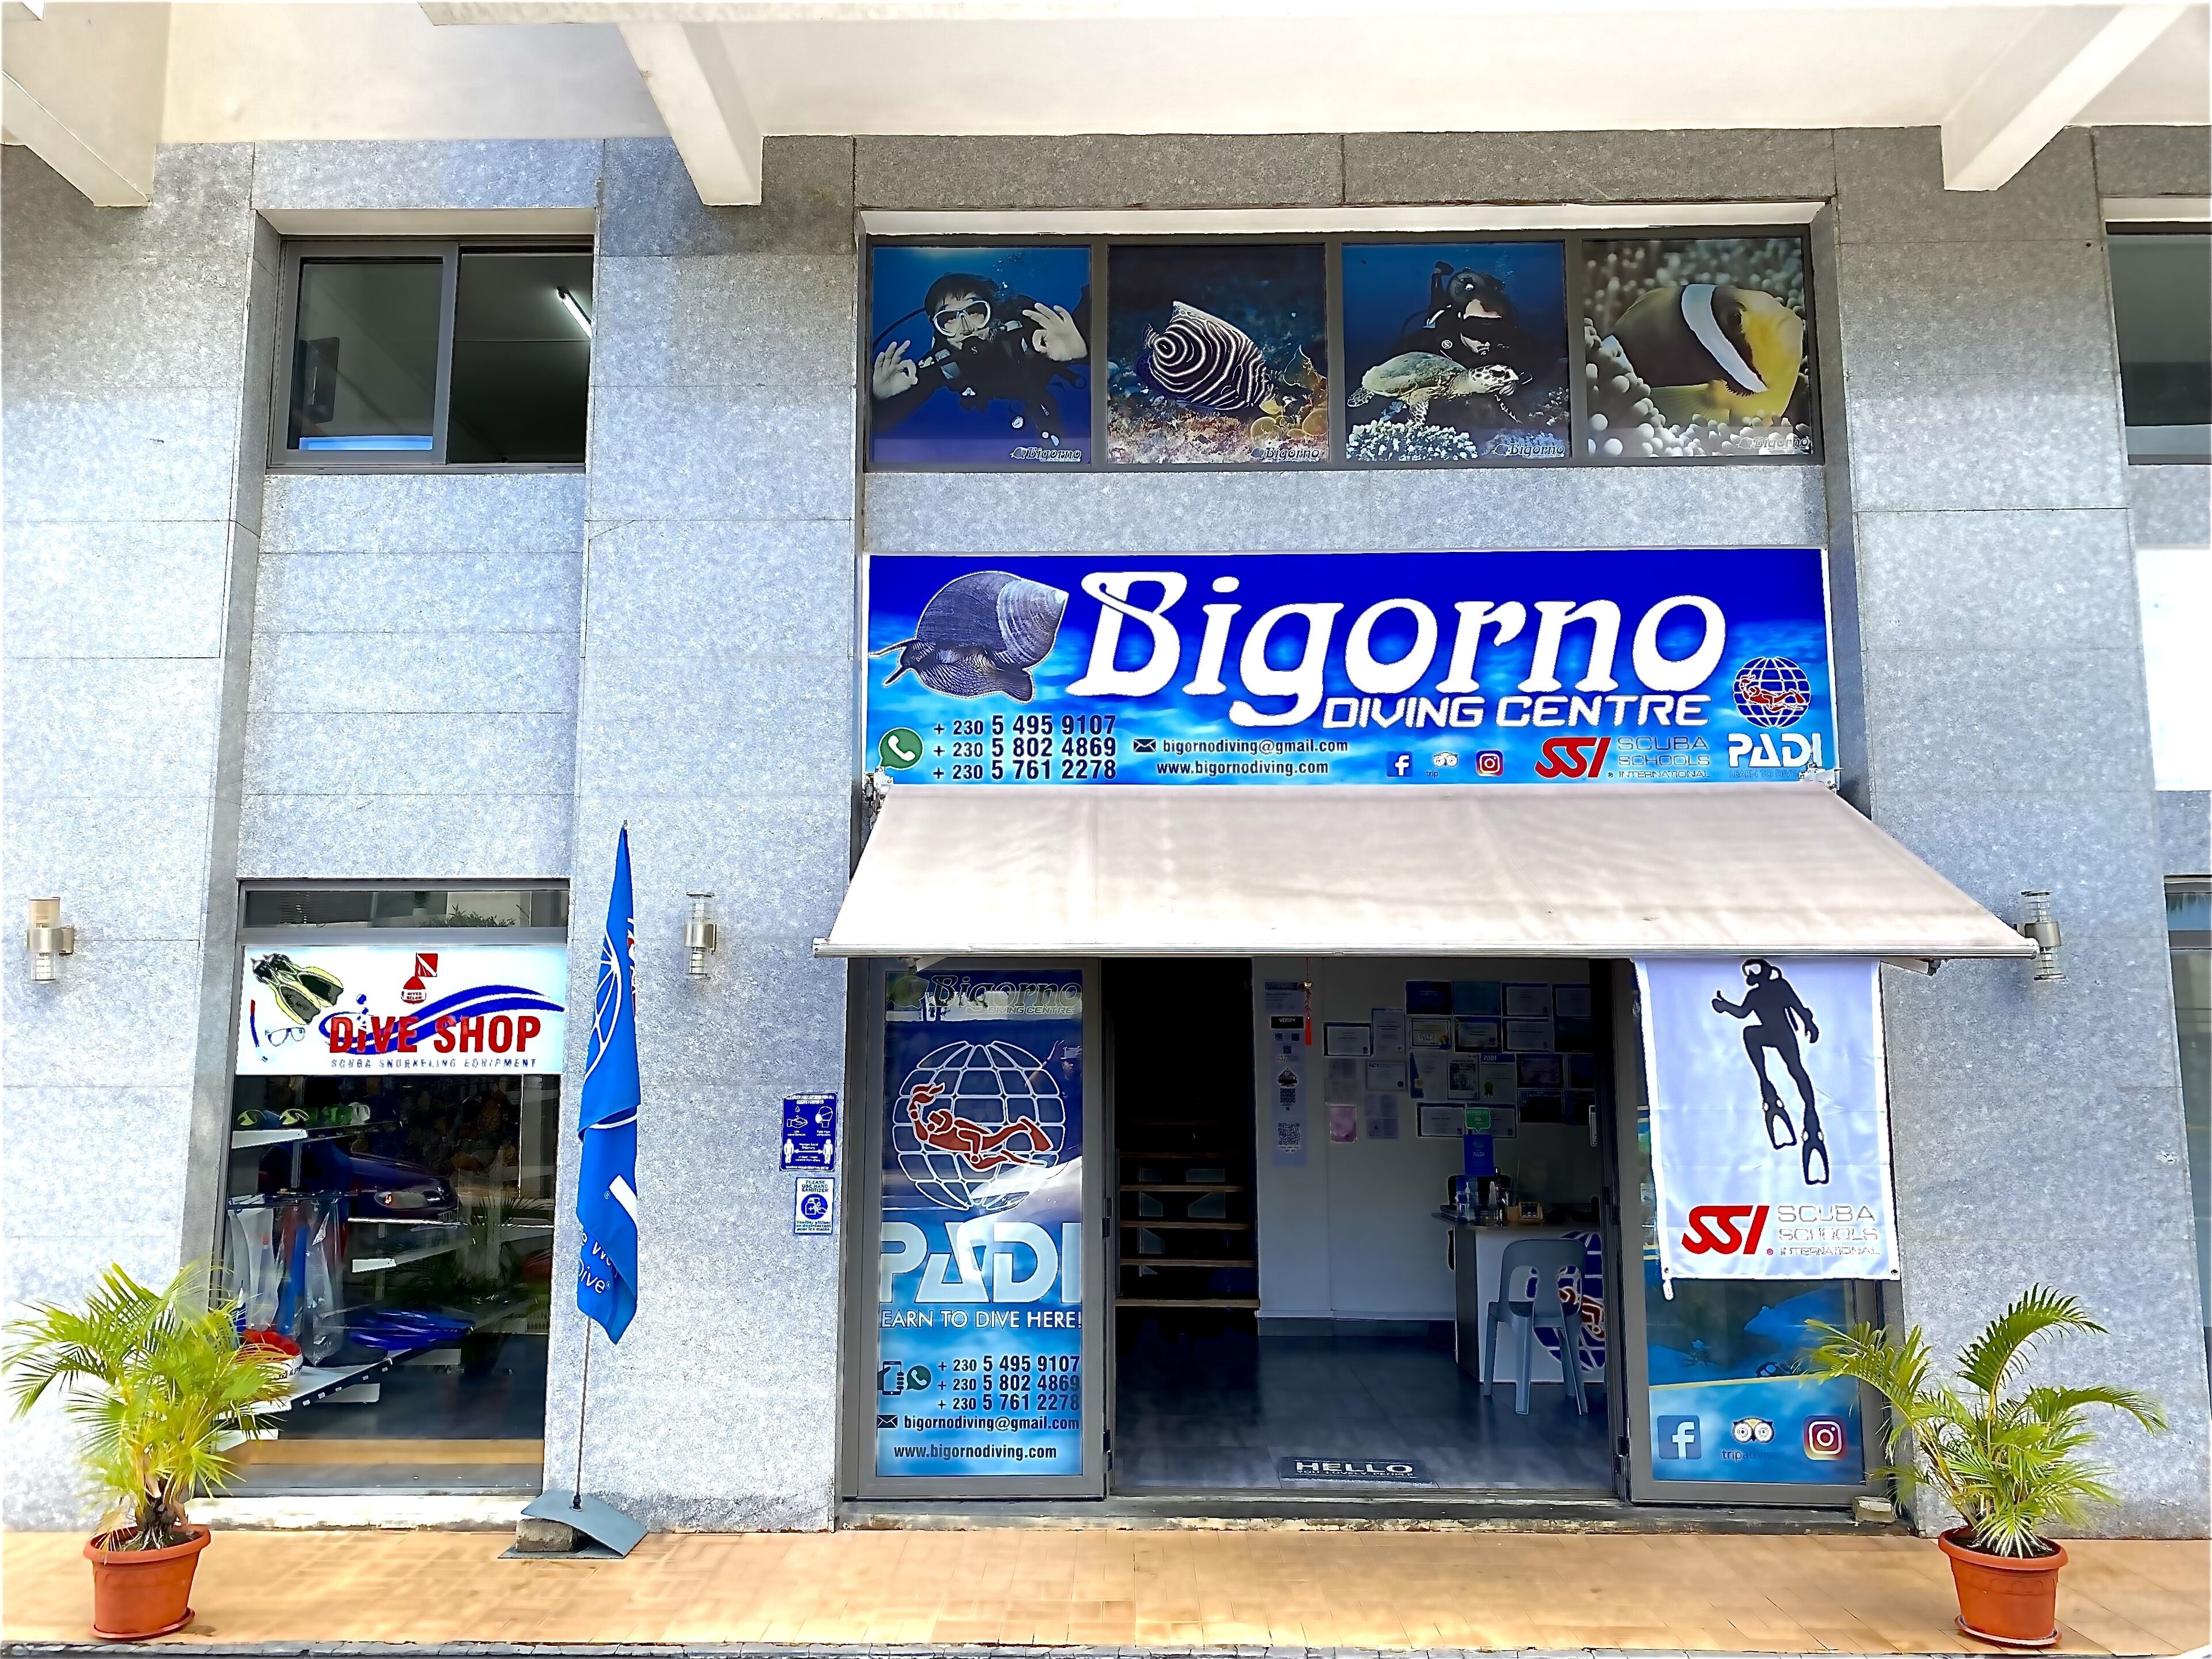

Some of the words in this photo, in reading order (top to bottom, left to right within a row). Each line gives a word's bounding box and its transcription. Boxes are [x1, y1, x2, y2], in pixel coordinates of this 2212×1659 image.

[1026, 447, 1081, 461] Bigorno
[1265, 447, 1320, 461] Bigorno
[1509, 443, 1565, 457] Bigorno
[1065, 571, 1726, 728] Bigorno
[1323, 695, 1485, 729] DIVING
[1495, 694, 1710, 728] CENTRE
[953, 720, 984, 735] 230
[992, 715, 1004, 735] 5
[1013, 715, 1053, 735] 495
[1062, 714, 1116, 735] 9107
[953, 742, 983, 757] 230
[992, 737, 1004, 757] 5
[1013, 737, 1053, 757] 802
[1062, 737, 1116, 757] 4869
[1163, 738, 1349, 755] bigornodiving@gmail.com
[1618, 736, 1709, 751] SCUBA
[1728, 733, 1823, 767] PADI
[1535, 737, 1612, 778] SSI
[1618, 755, 1710, 767] SCHOOLS
[952, 764, 983, 779] 230
[991, 759, 1003, 779] 5
[1013, 759, 1051, 779] 761
[1062, 759, 1116, 779] 2278
[1157, 760, 1329, 777] www.bigornodiving.com
[1618, 770, 1711, 778] INTERNATIONAL
[1730, 770, 1757, 778] LEARN
[1760, 770, 1773, 778] TO
[1776, 770, 1797, 778] DIVE
[931, 975, 1082, 1015] Bigorno
[986, 1007, 1025, 1015] DIVING
[1025, 1007, 1075, 1015] CENTRE
[434, 1016, 541, 1053] SHOP
[331, 1059, 372, 1068] SCUBA
[379, 1058, 456, 1068] SNORKELING
[464, 1058, 537, 1067] EQUIPMENT
[1777, 1205, 1876, 1223] SCUBA
[1681, 1205, 1770, 1255] SSI
[1778, 1228, 1878, 1241] SCHOOLS
[1779, 1247, 1881, 1256] INTERNATIONAL
[880, 1222, 1082, 1303] PADI
[880, 1309, 934, 1328] EARN
[940, 1310, 969, 1329] TO
[975, 1310, 1020, 1329] DIVE
[1027, 1310, 1082, 1329] HERE!
[953, 1359, 977, 1372] 230
[983, 1355, 993, 1372] 5
[999, 1355, 1031, 1372] 495
[1037, 1355, 1080, 1372] 9107
[953, 1378, 976, 1391] 230
[983, 1374, 993, 1391] 5
[999, 1374, 1031, 1391] 802
[1037, 1374, 1080, 1391] 4869
[953, 1398, 976, 1410] 230
[983, 1394, 992, 1410] 5
[1001, 1394, 1029, 1410] 761
[1037, 1394, 1080, 1411] 2278
[904, 1415, 1080, 1431] bigornodiving@gmail.com
[894, 1444, 1056, 1461] www.bigornodiving.com
[1297, 1462, 1413, 1473] HELLO
